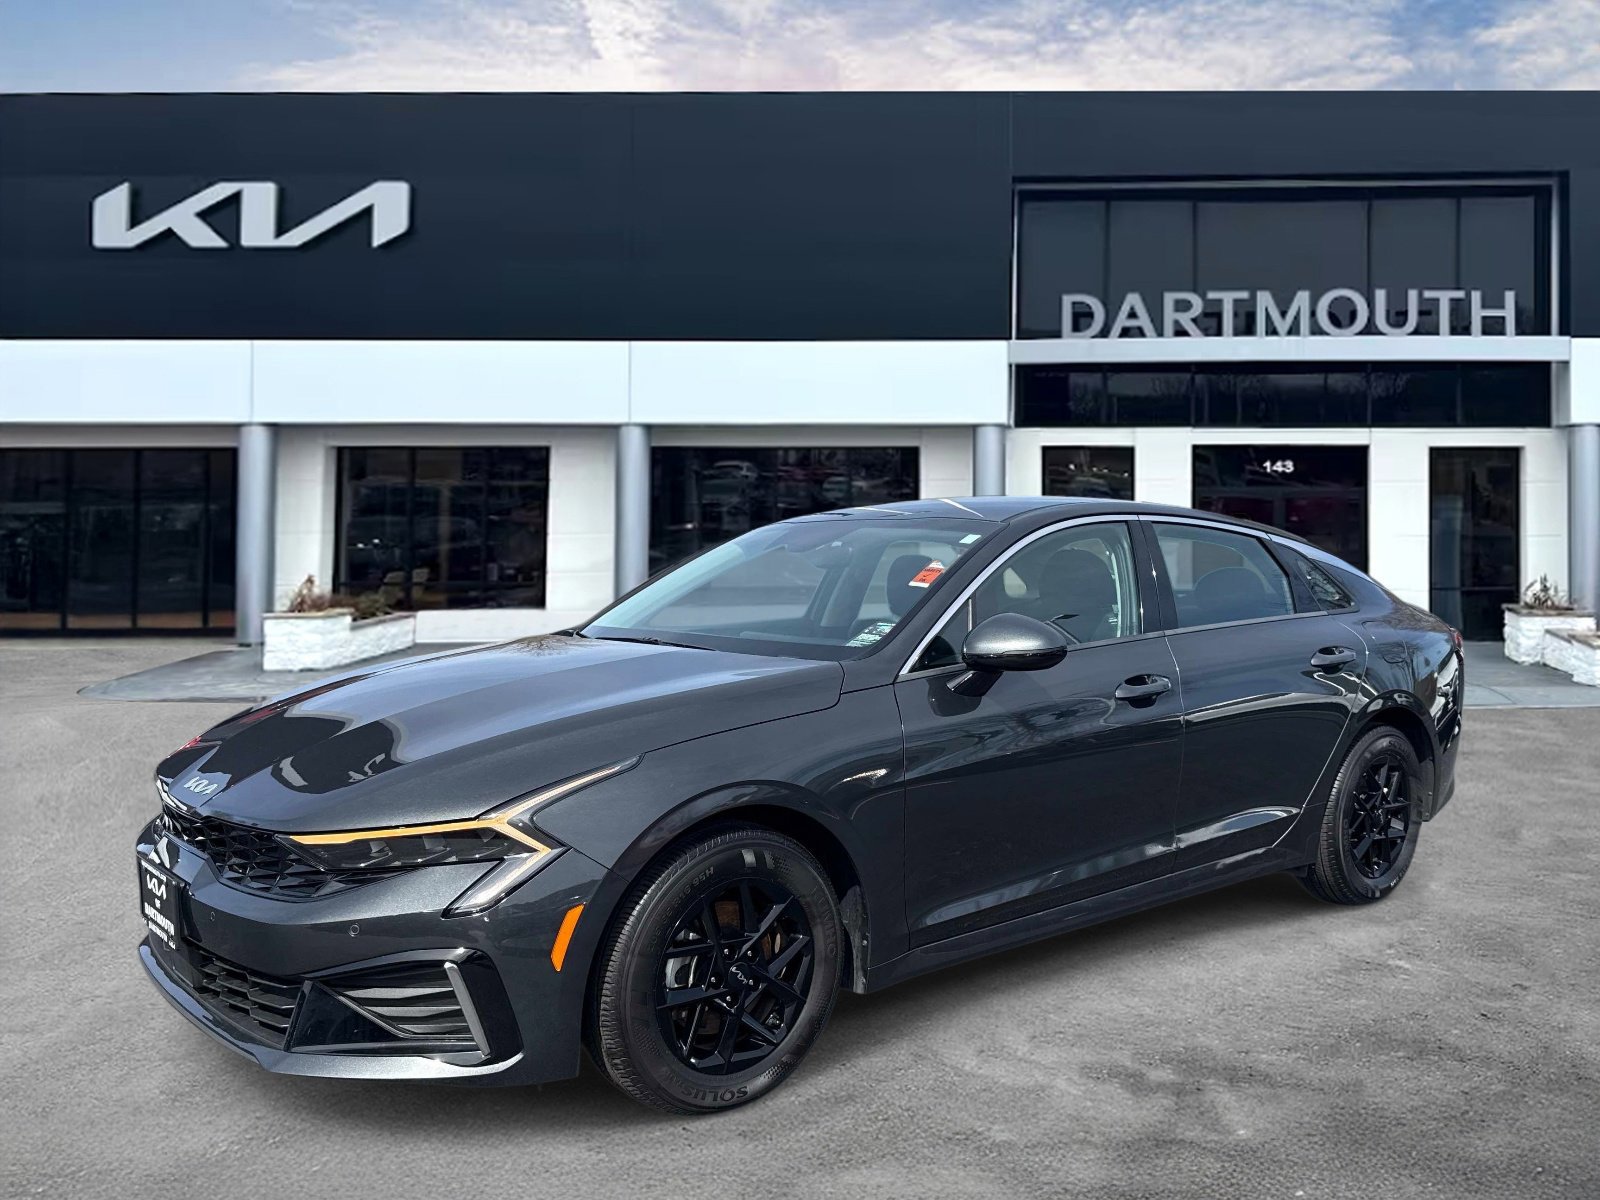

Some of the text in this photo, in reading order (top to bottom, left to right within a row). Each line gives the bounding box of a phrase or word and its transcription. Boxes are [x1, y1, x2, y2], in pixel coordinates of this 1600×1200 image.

[92, 180, 410, 248] KIA
[1061, 288, 1517, 338] DARTMOUTH
[1262, 459, 1295, 473] 143
[183, 776, 219, 796] KIA
[146, 873, 167, 901] KIA
[692, 865, 715, 888] 95H
[680, 1085, 749, 1102] SOLUS
